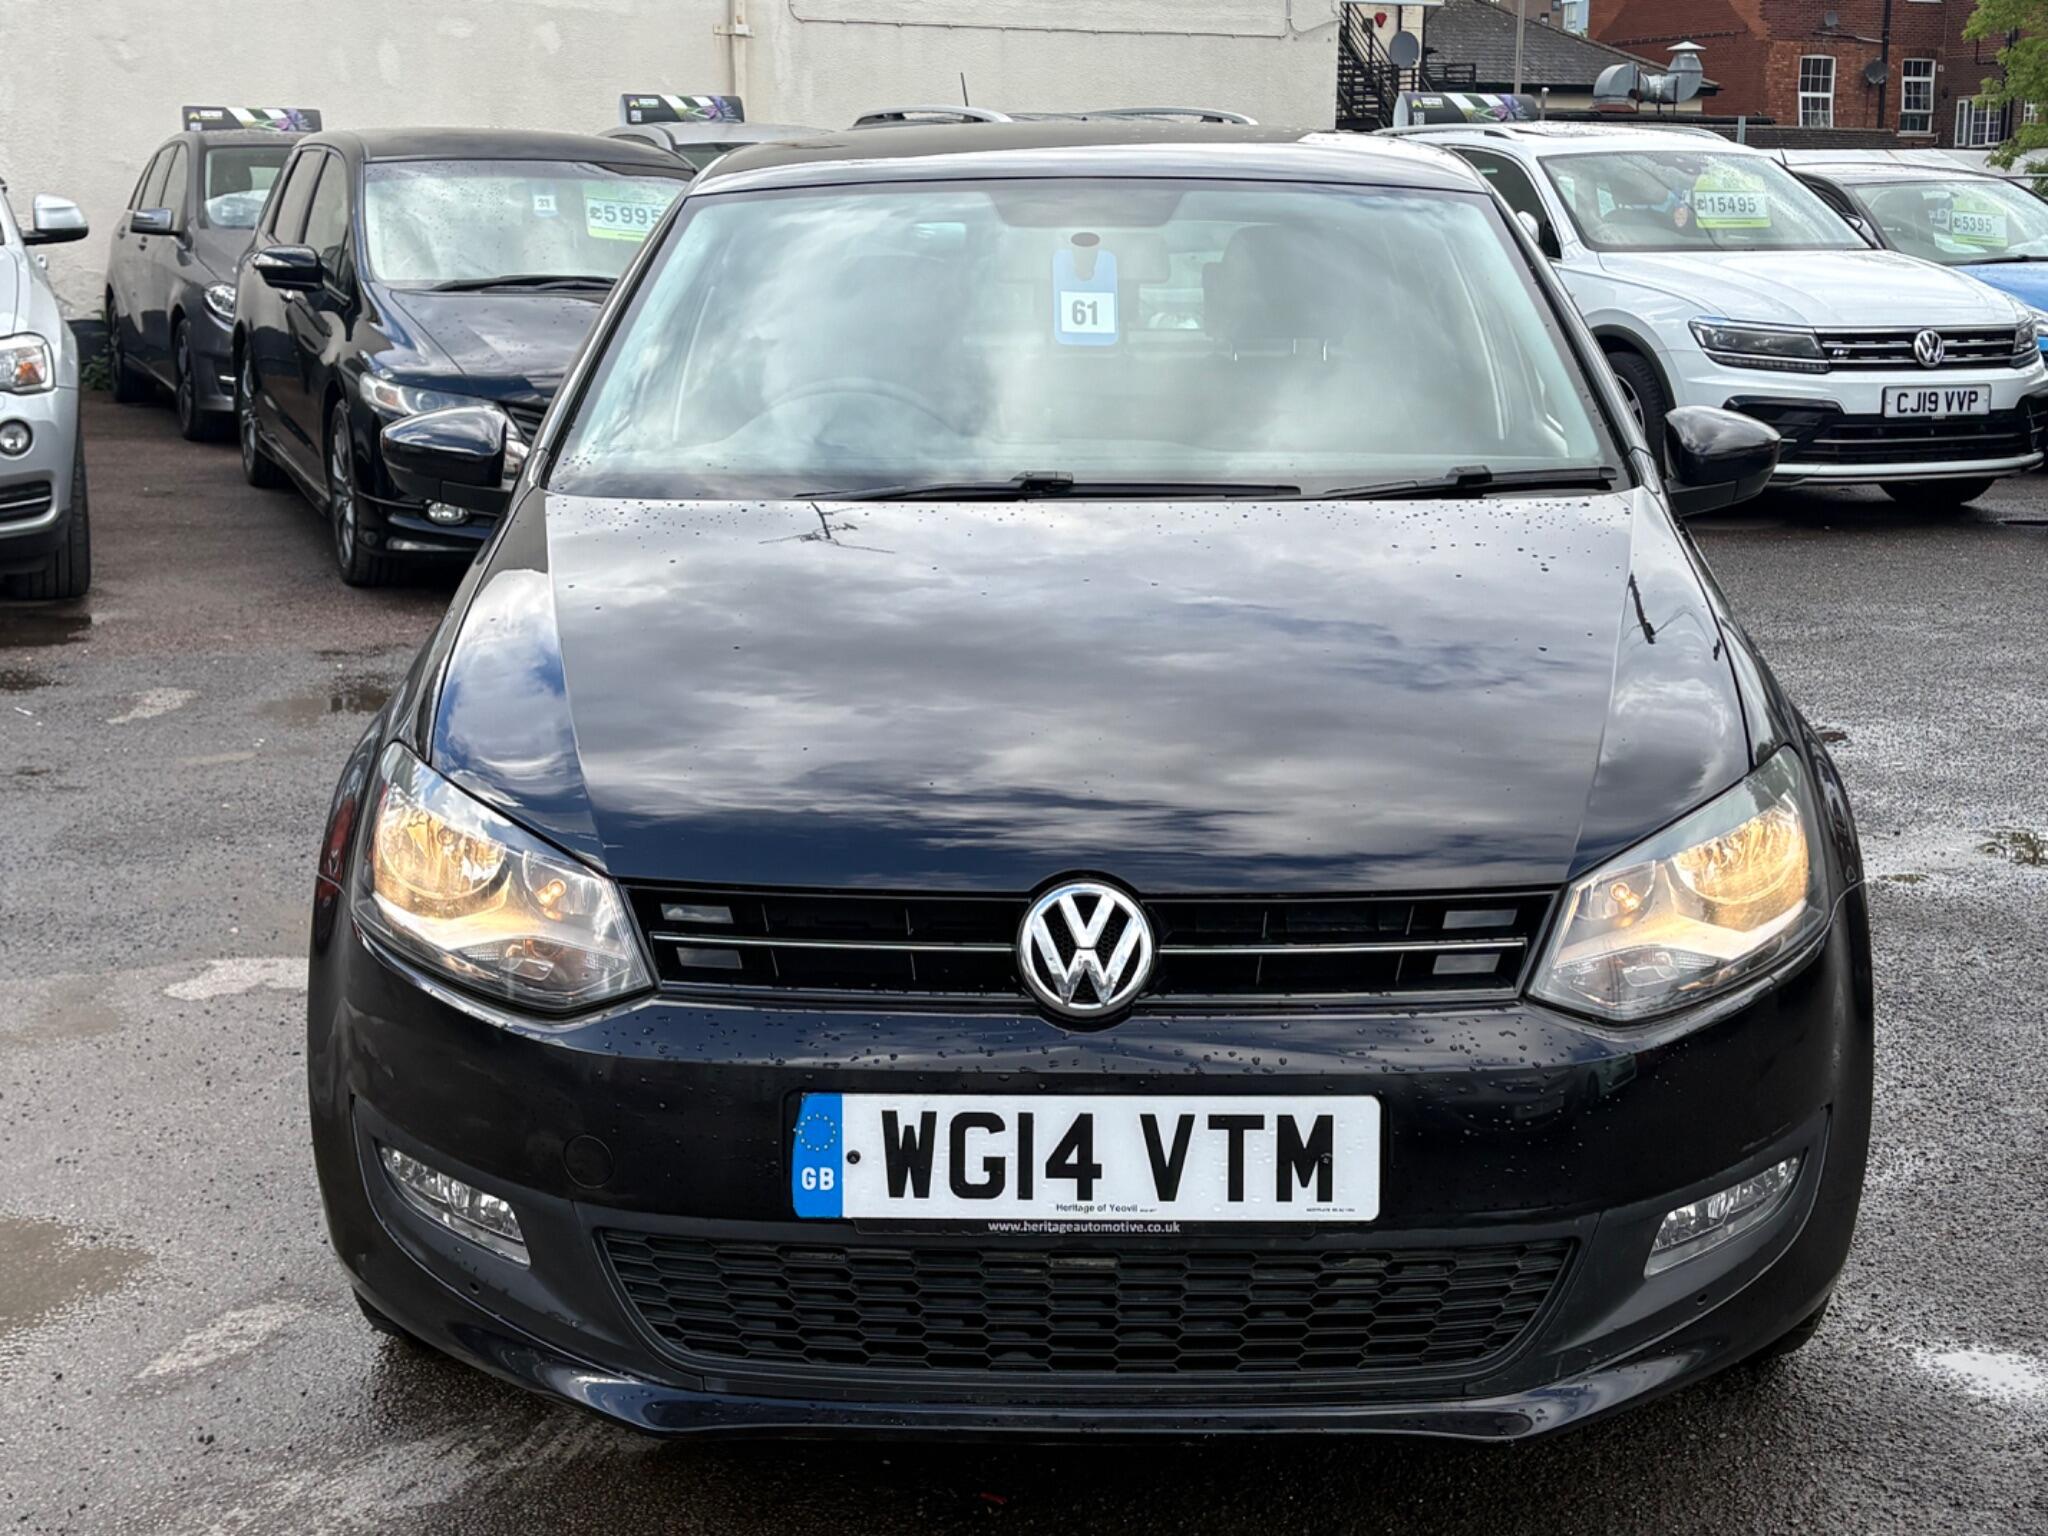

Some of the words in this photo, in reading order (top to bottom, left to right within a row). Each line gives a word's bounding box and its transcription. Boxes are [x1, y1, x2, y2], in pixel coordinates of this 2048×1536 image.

[1697, 196, 1757, 213] £15495
[1954, 216, 1992, 232] £5395
[1072, 299, 1098, 326] 61
[1896, 392, 1938, 413] CJ19
[1945, 391, 1979, 412] VVP
[881, 1110, 1102, 1201] WG14
[1139, 1113, 1334, 1203] VTM
[801, 1166, 835, 1191] GB
[1055, 1203, 1095, 1214] Heritage
[1097, 1203, 1107, 1212] of
[1109, 1203, 1138, 1213] Yeovil
[987, 1220, 1181, 1234] www.heritageautomotive.co.uk
